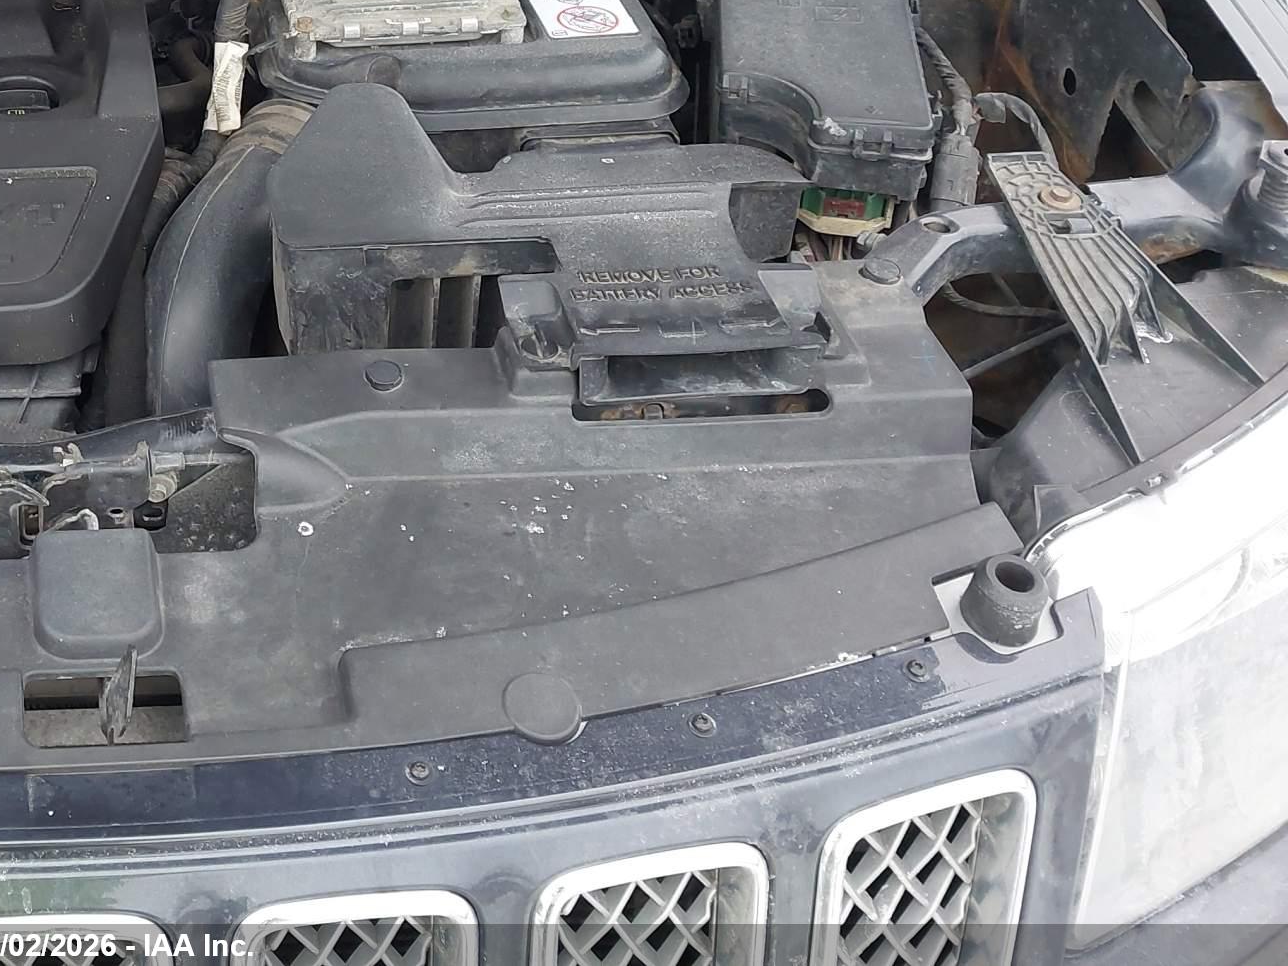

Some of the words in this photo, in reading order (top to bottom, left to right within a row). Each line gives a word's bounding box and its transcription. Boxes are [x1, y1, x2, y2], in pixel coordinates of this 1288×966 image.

[577, 268, 672, 284] REMOVE
[674, 265, 721, 280] FOR
[569, 286, 662, 302] BATTERY
[668, 281, 754, 300] ACCESS
